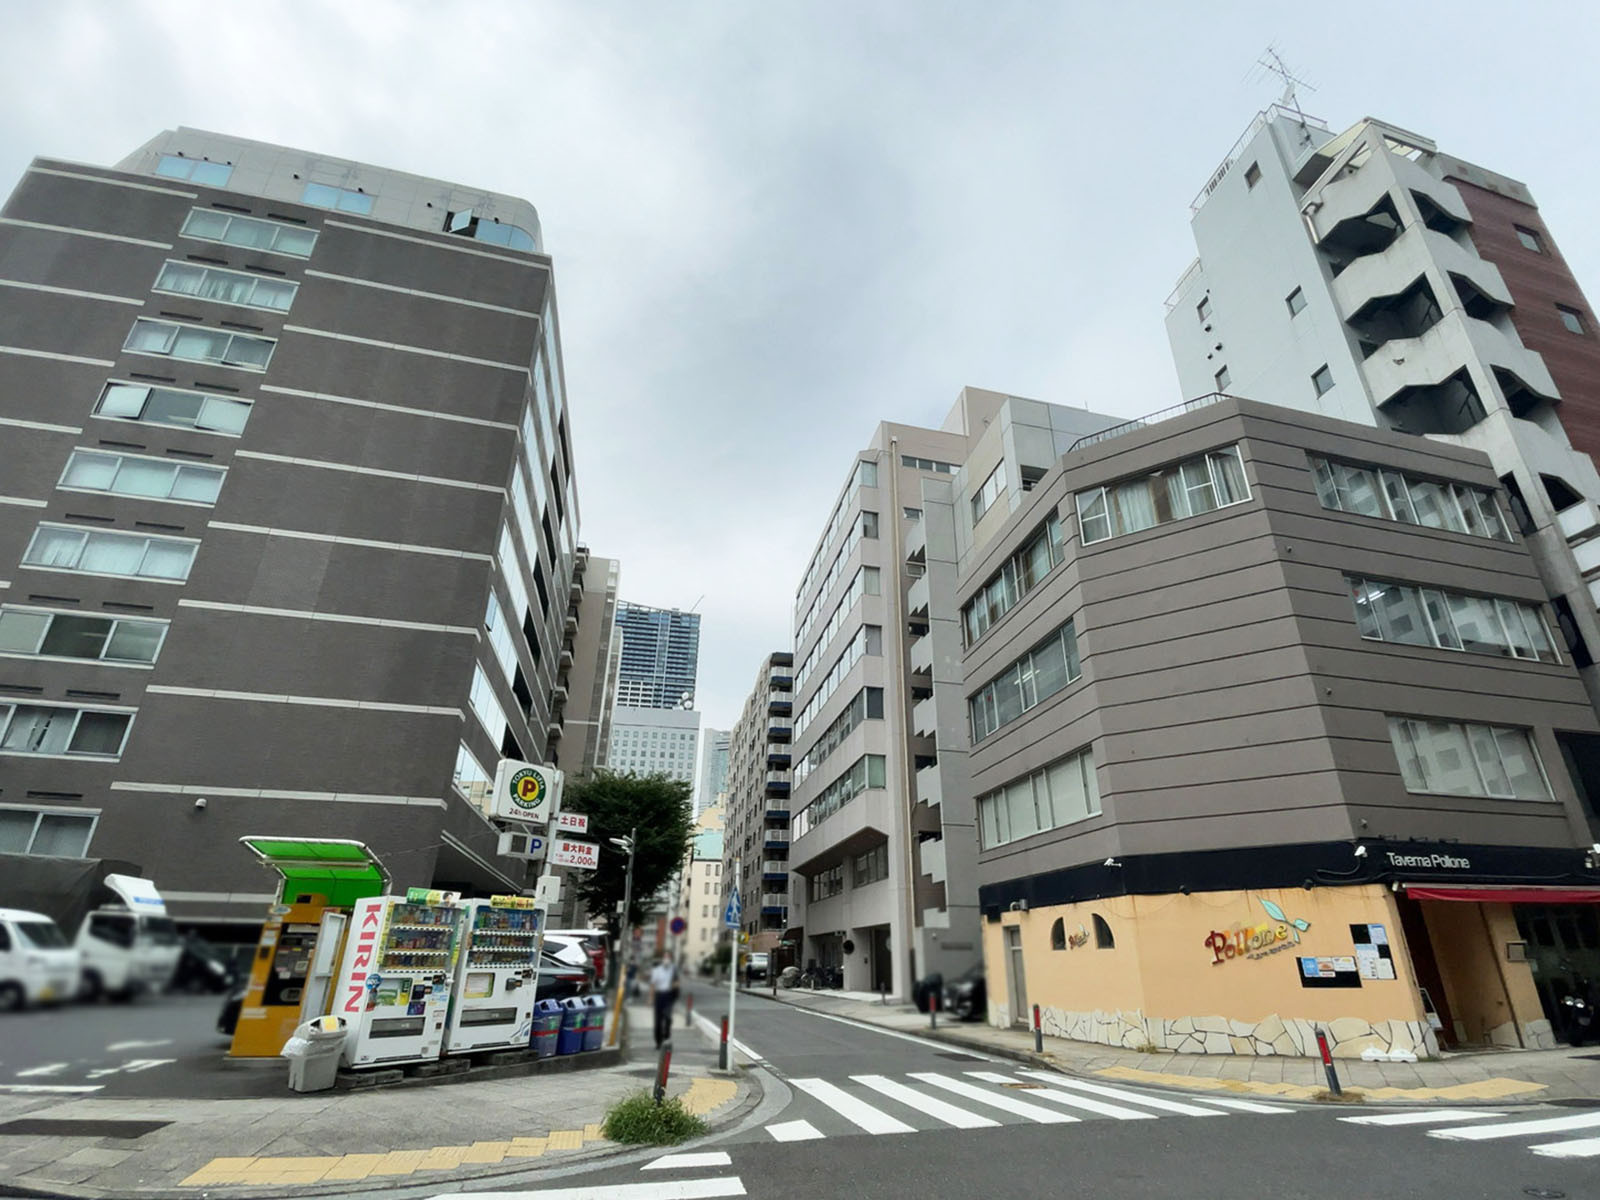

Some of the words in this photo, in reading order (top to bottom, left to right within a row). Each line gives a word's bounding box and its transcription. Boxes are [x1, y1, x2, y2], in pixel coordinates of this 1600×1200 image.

[521, 779, 537, 797] P
[513, 793, 541, 807] PARKING
[523, 811, 539, 819] OPEN
[530, 838, 542, 854] P
[1386, 852, 1432, 867] Taverna
[1431, 854, 1470, 869] Pollone
[1205, 924, 1288, 965] Pollone
[344, 904, 382, 1012] KIRIN
